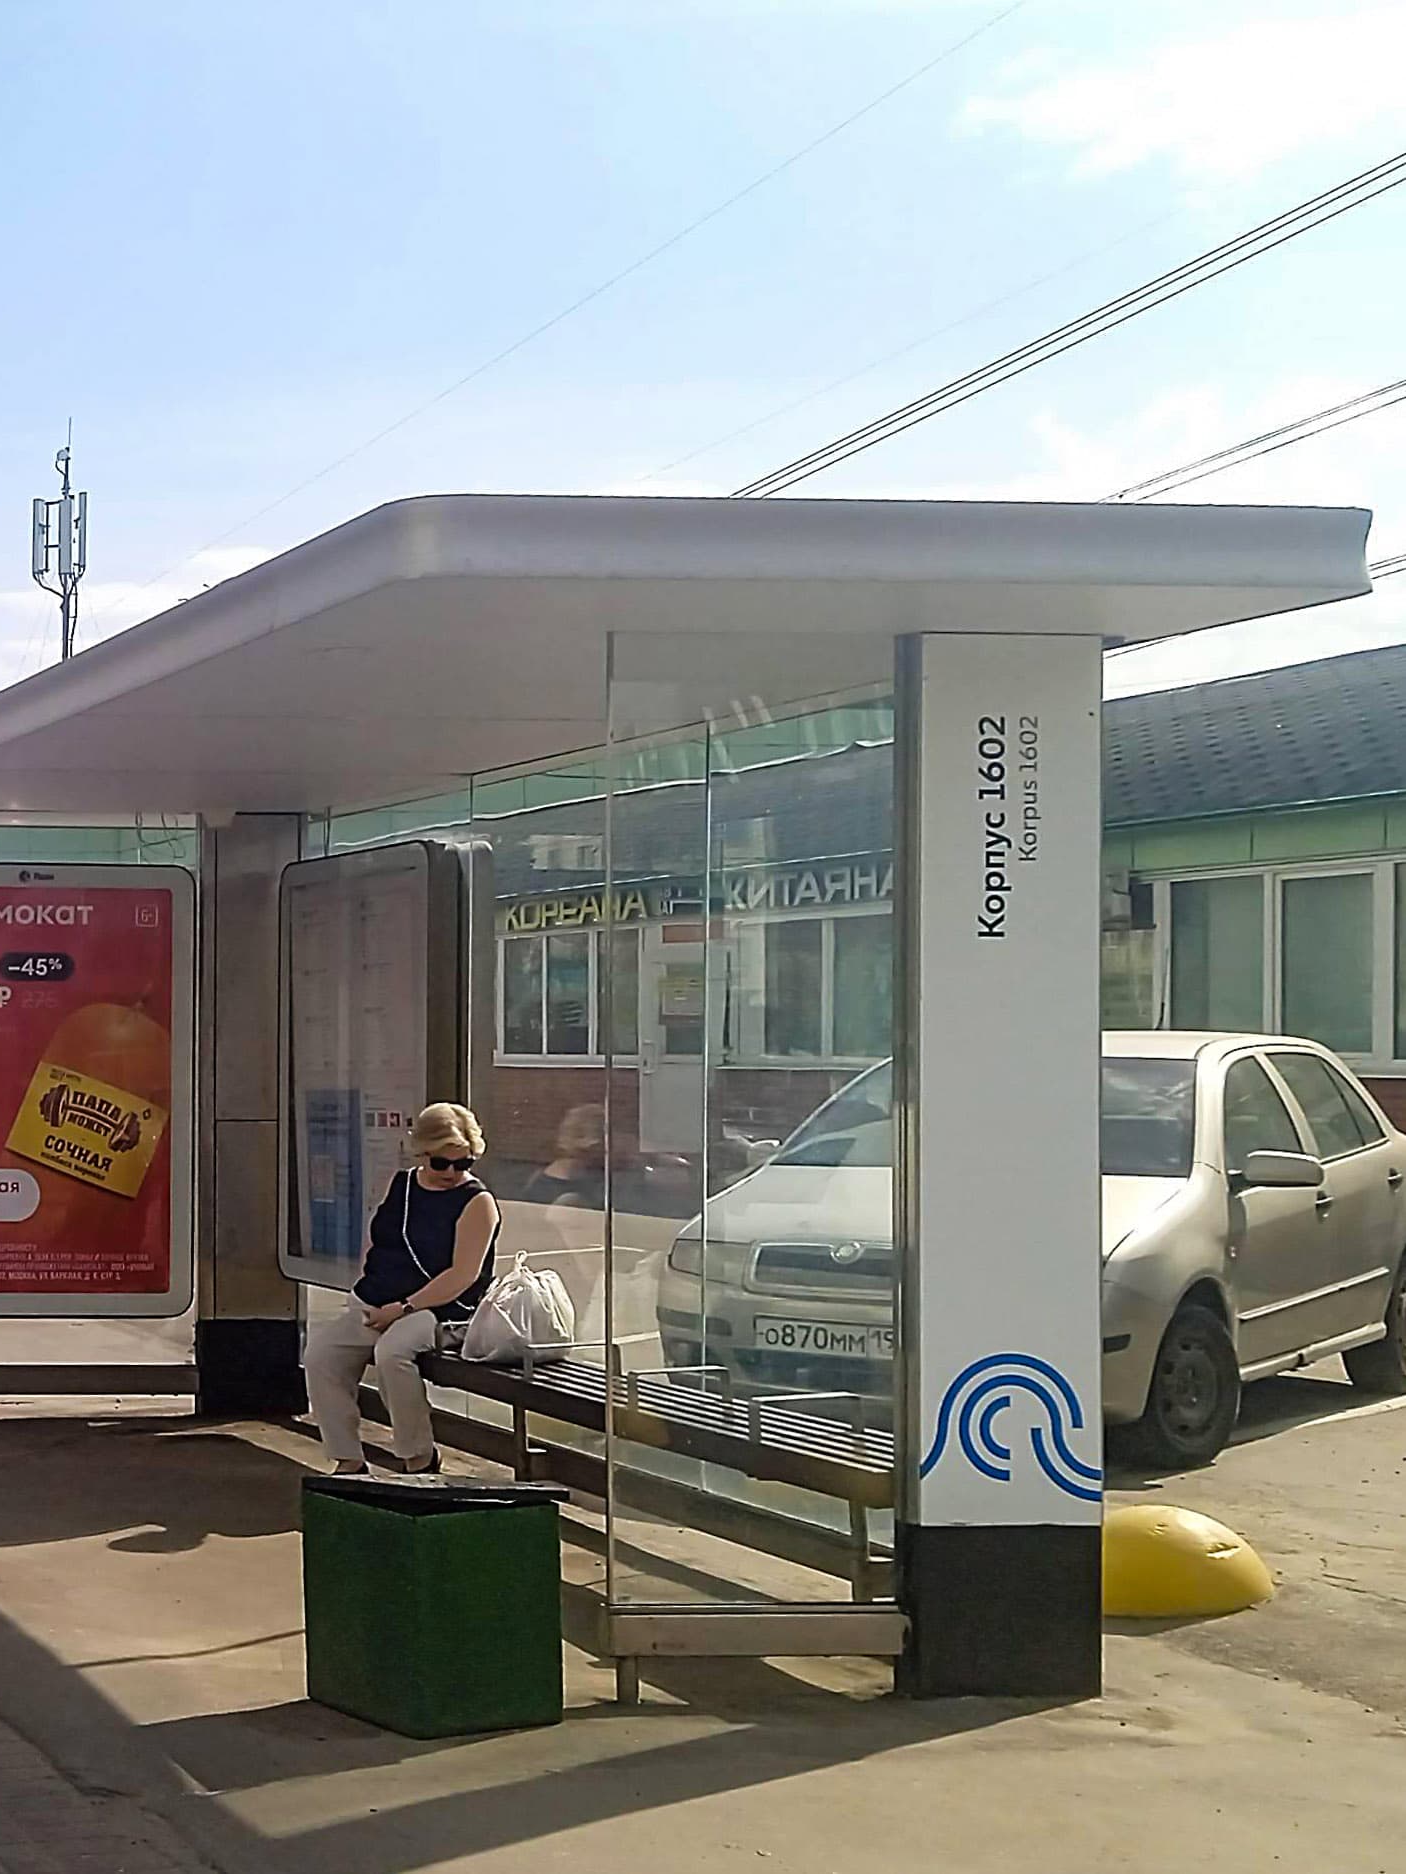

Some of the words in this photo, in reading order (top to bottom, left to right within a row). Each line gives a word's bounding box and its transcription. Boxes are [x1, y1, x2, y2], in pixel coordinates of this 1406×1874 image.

[978, 716, 1005, 800] 1602
[1018, 716, 1038, 772] 1602
[1018, 780, 1042, 861] Korpus
[978, 812, 1012, 937] Корпус
[505, 890, 648, 932] КОРЕАНА
[67, 1113, 112, 1137] МОЖЕТ
[72, 1090, 122, 1122] ПАПА
[44, 1134, 114, 1172] СОЧНАЯ
